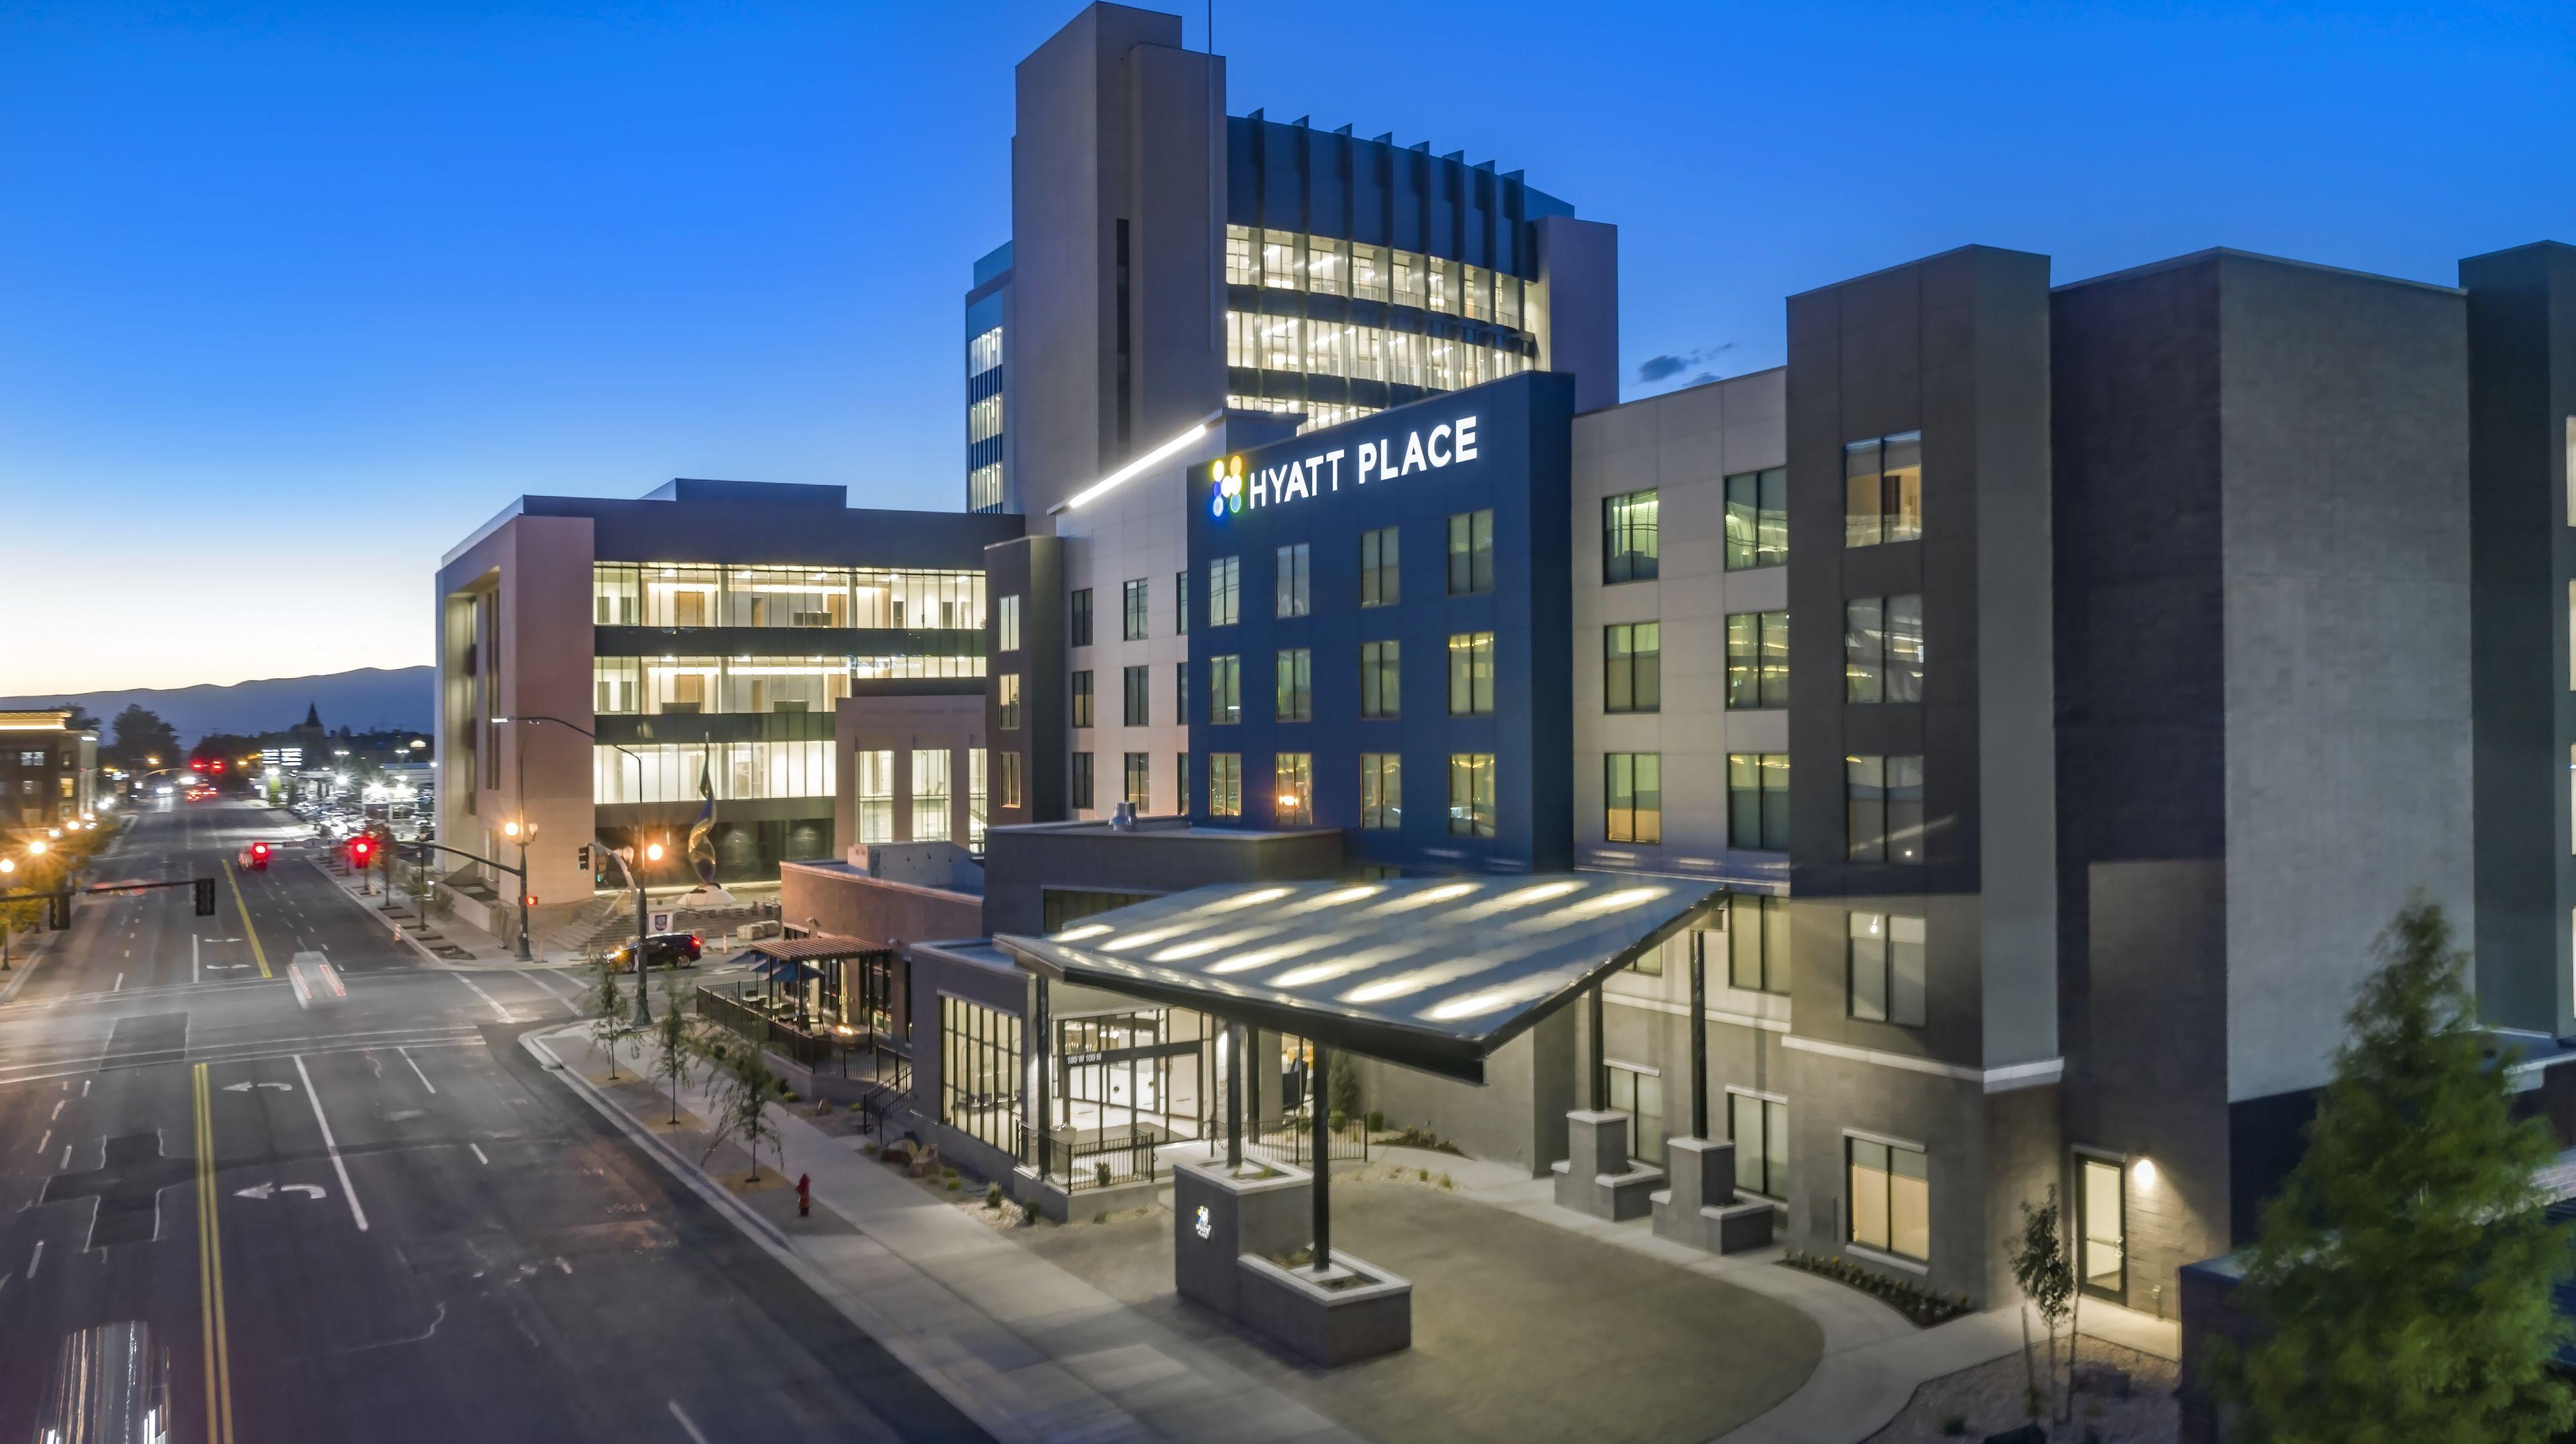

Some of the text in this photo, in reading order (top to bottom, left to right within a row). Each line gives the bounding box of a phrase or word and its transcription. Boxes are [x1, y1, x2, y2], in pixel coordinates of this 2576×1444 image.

[1250, 415, 1477, 509] HYATT PLACE
[1078, 1054, 1085, 1063] W
[1096, 1052, 1102, 1061] N
